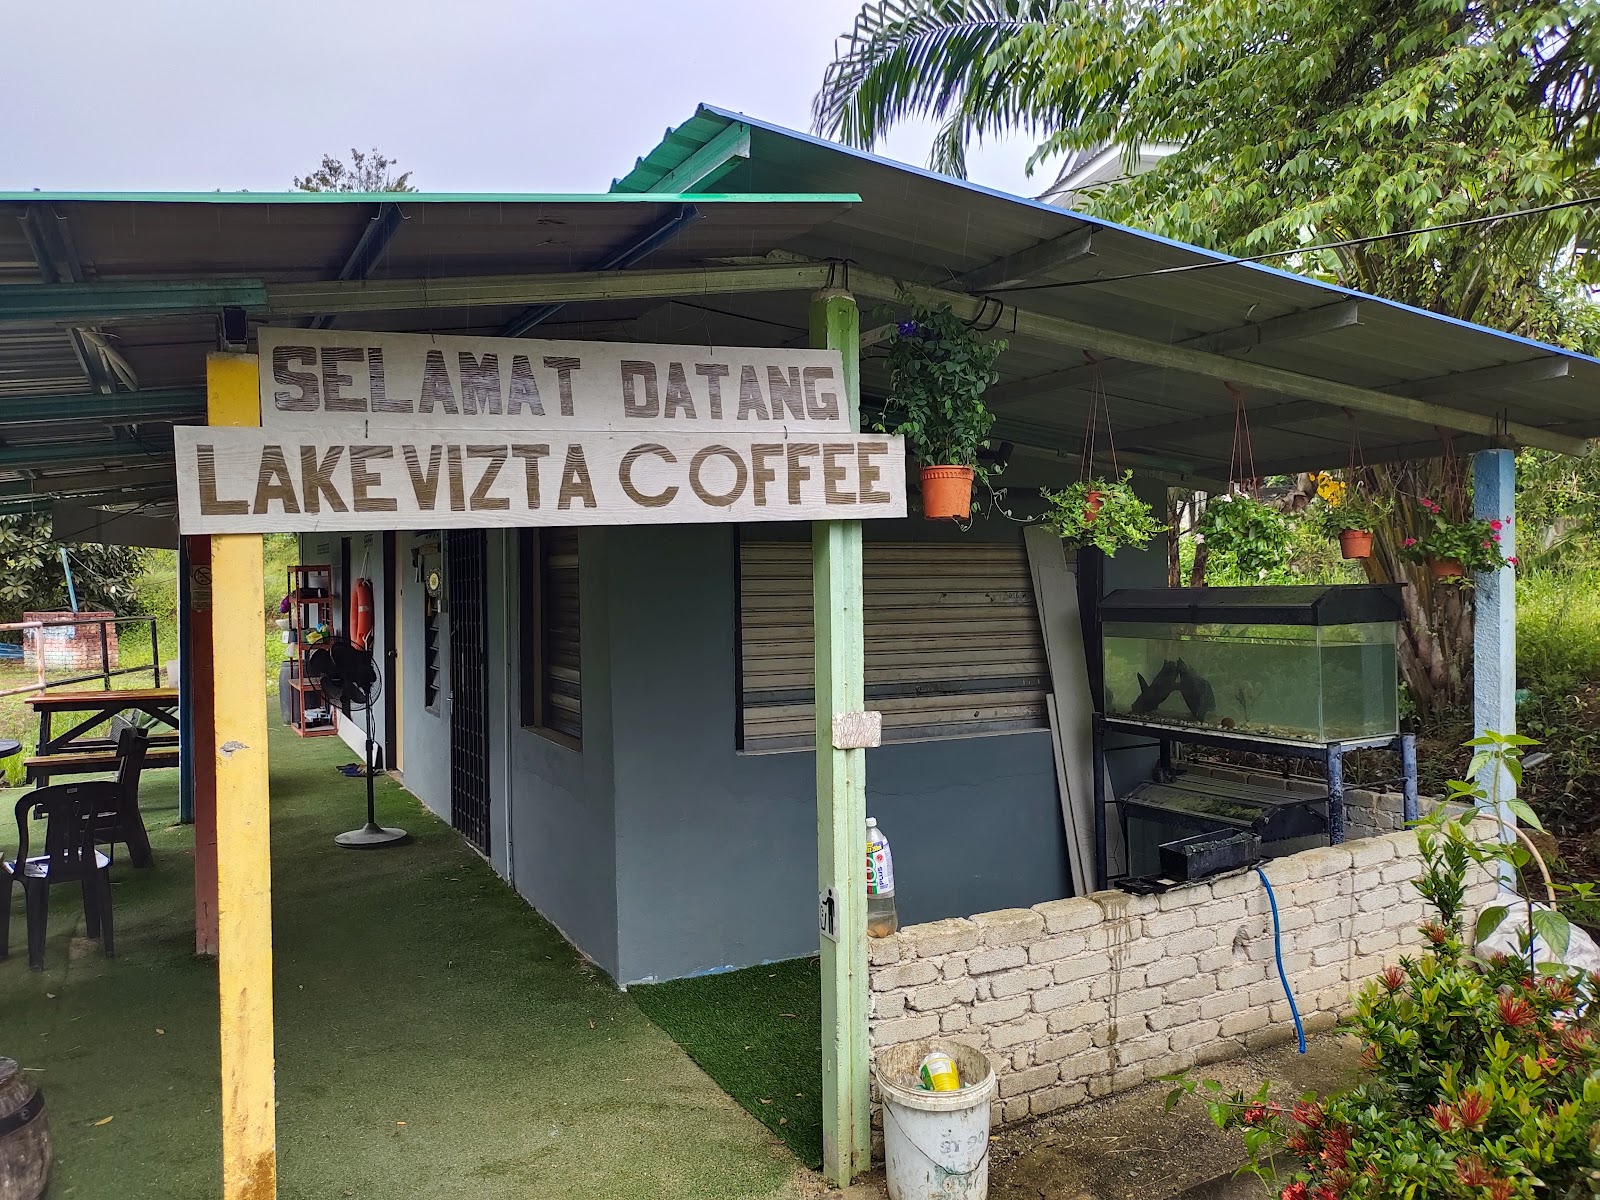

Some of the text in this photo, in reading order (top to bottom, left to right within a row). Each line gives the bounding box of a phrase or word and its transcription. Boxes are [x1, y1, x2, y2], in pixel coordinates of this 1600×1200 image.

[273, 346, 839, 421] SELAMAT DATANG
[198, 443, 891, 515] LAKEVIZTA COFFEE
